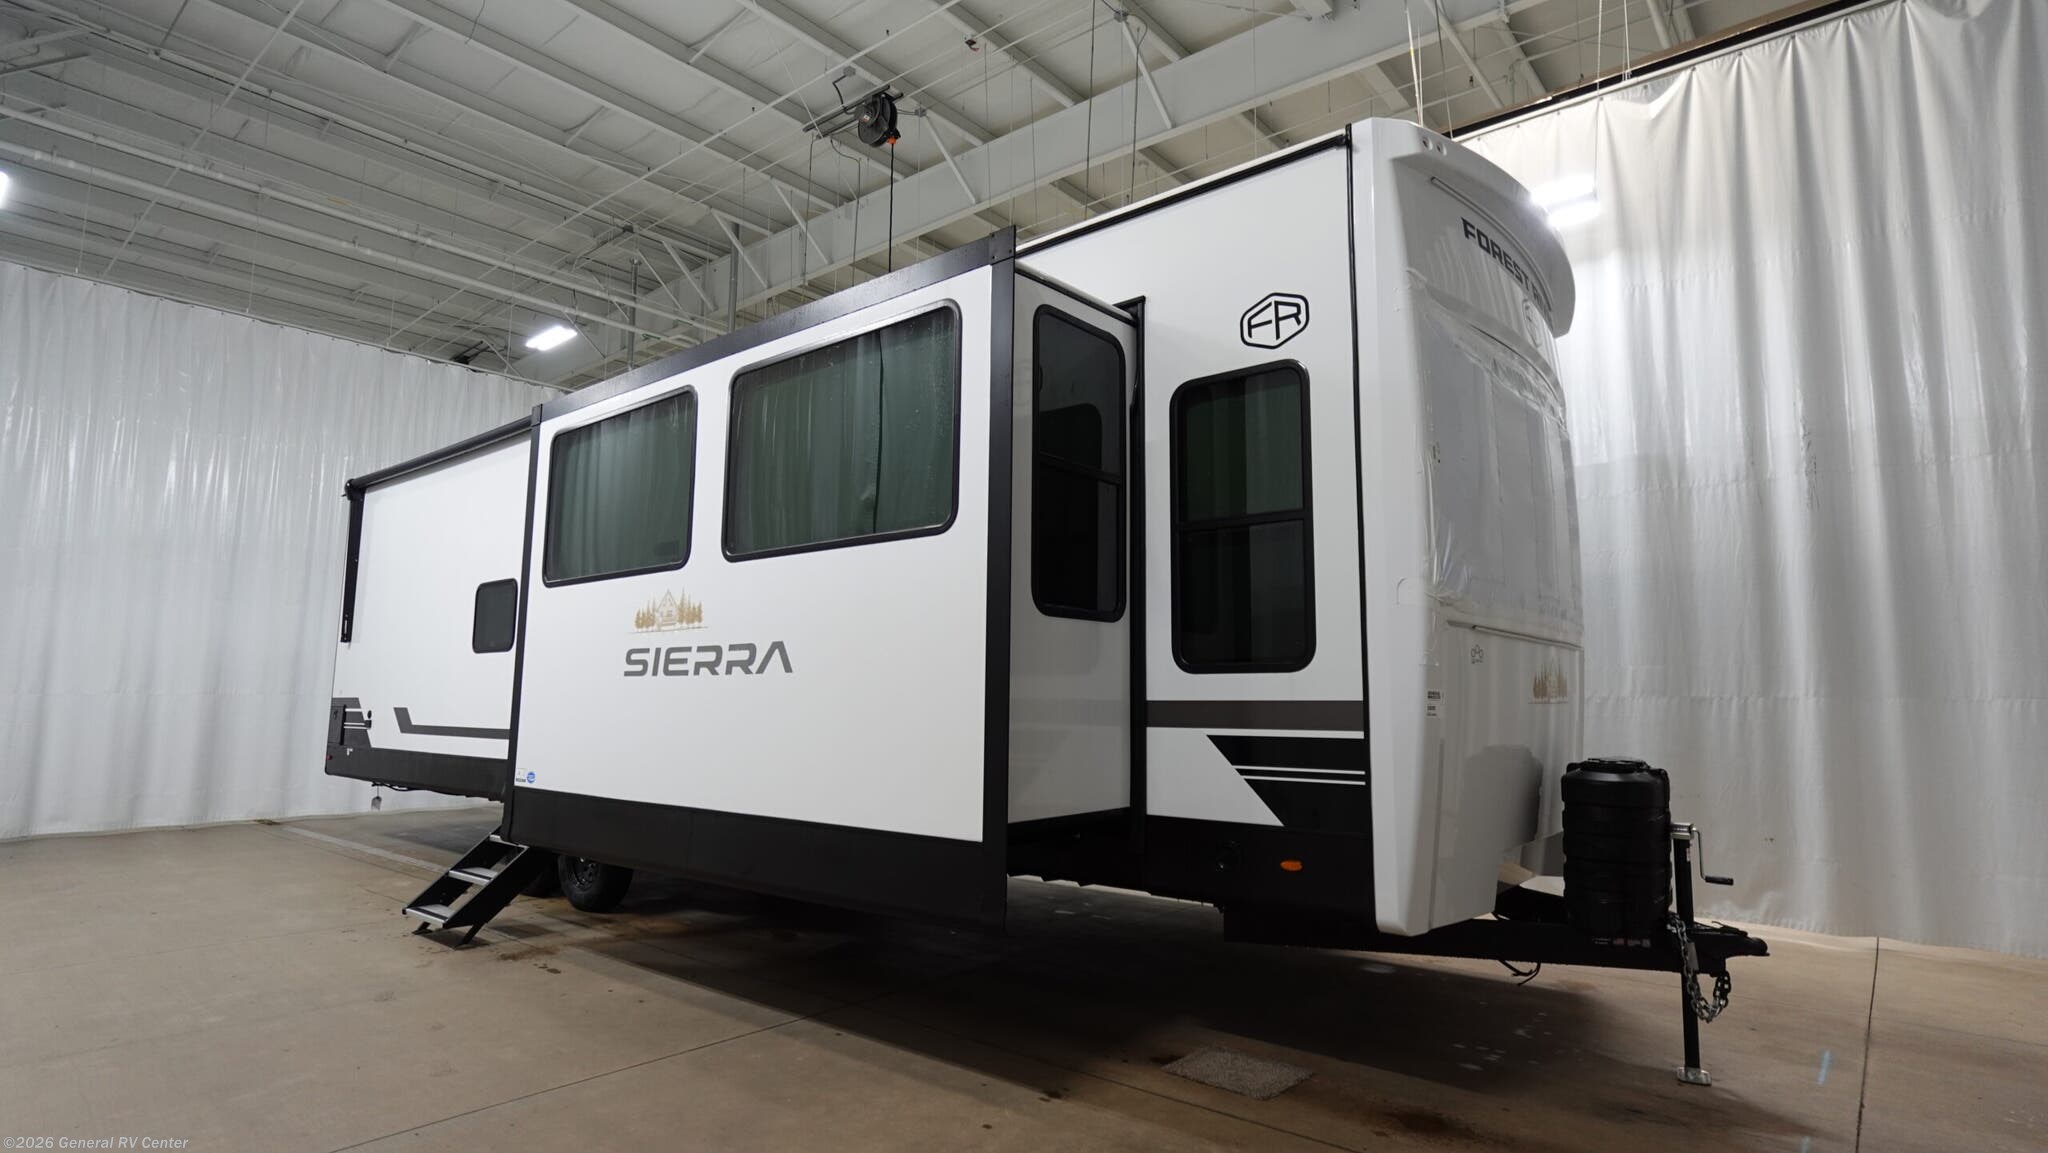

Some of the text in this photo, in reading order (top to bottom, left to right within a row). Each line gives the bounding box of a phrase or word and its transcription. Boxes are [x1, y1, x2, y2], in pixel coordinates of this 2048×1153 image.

[1460, 216, 1530, 292] FOREST
[1246, 299, 1303, 341] FR
[623, 640, 794, 677] SIERRA
